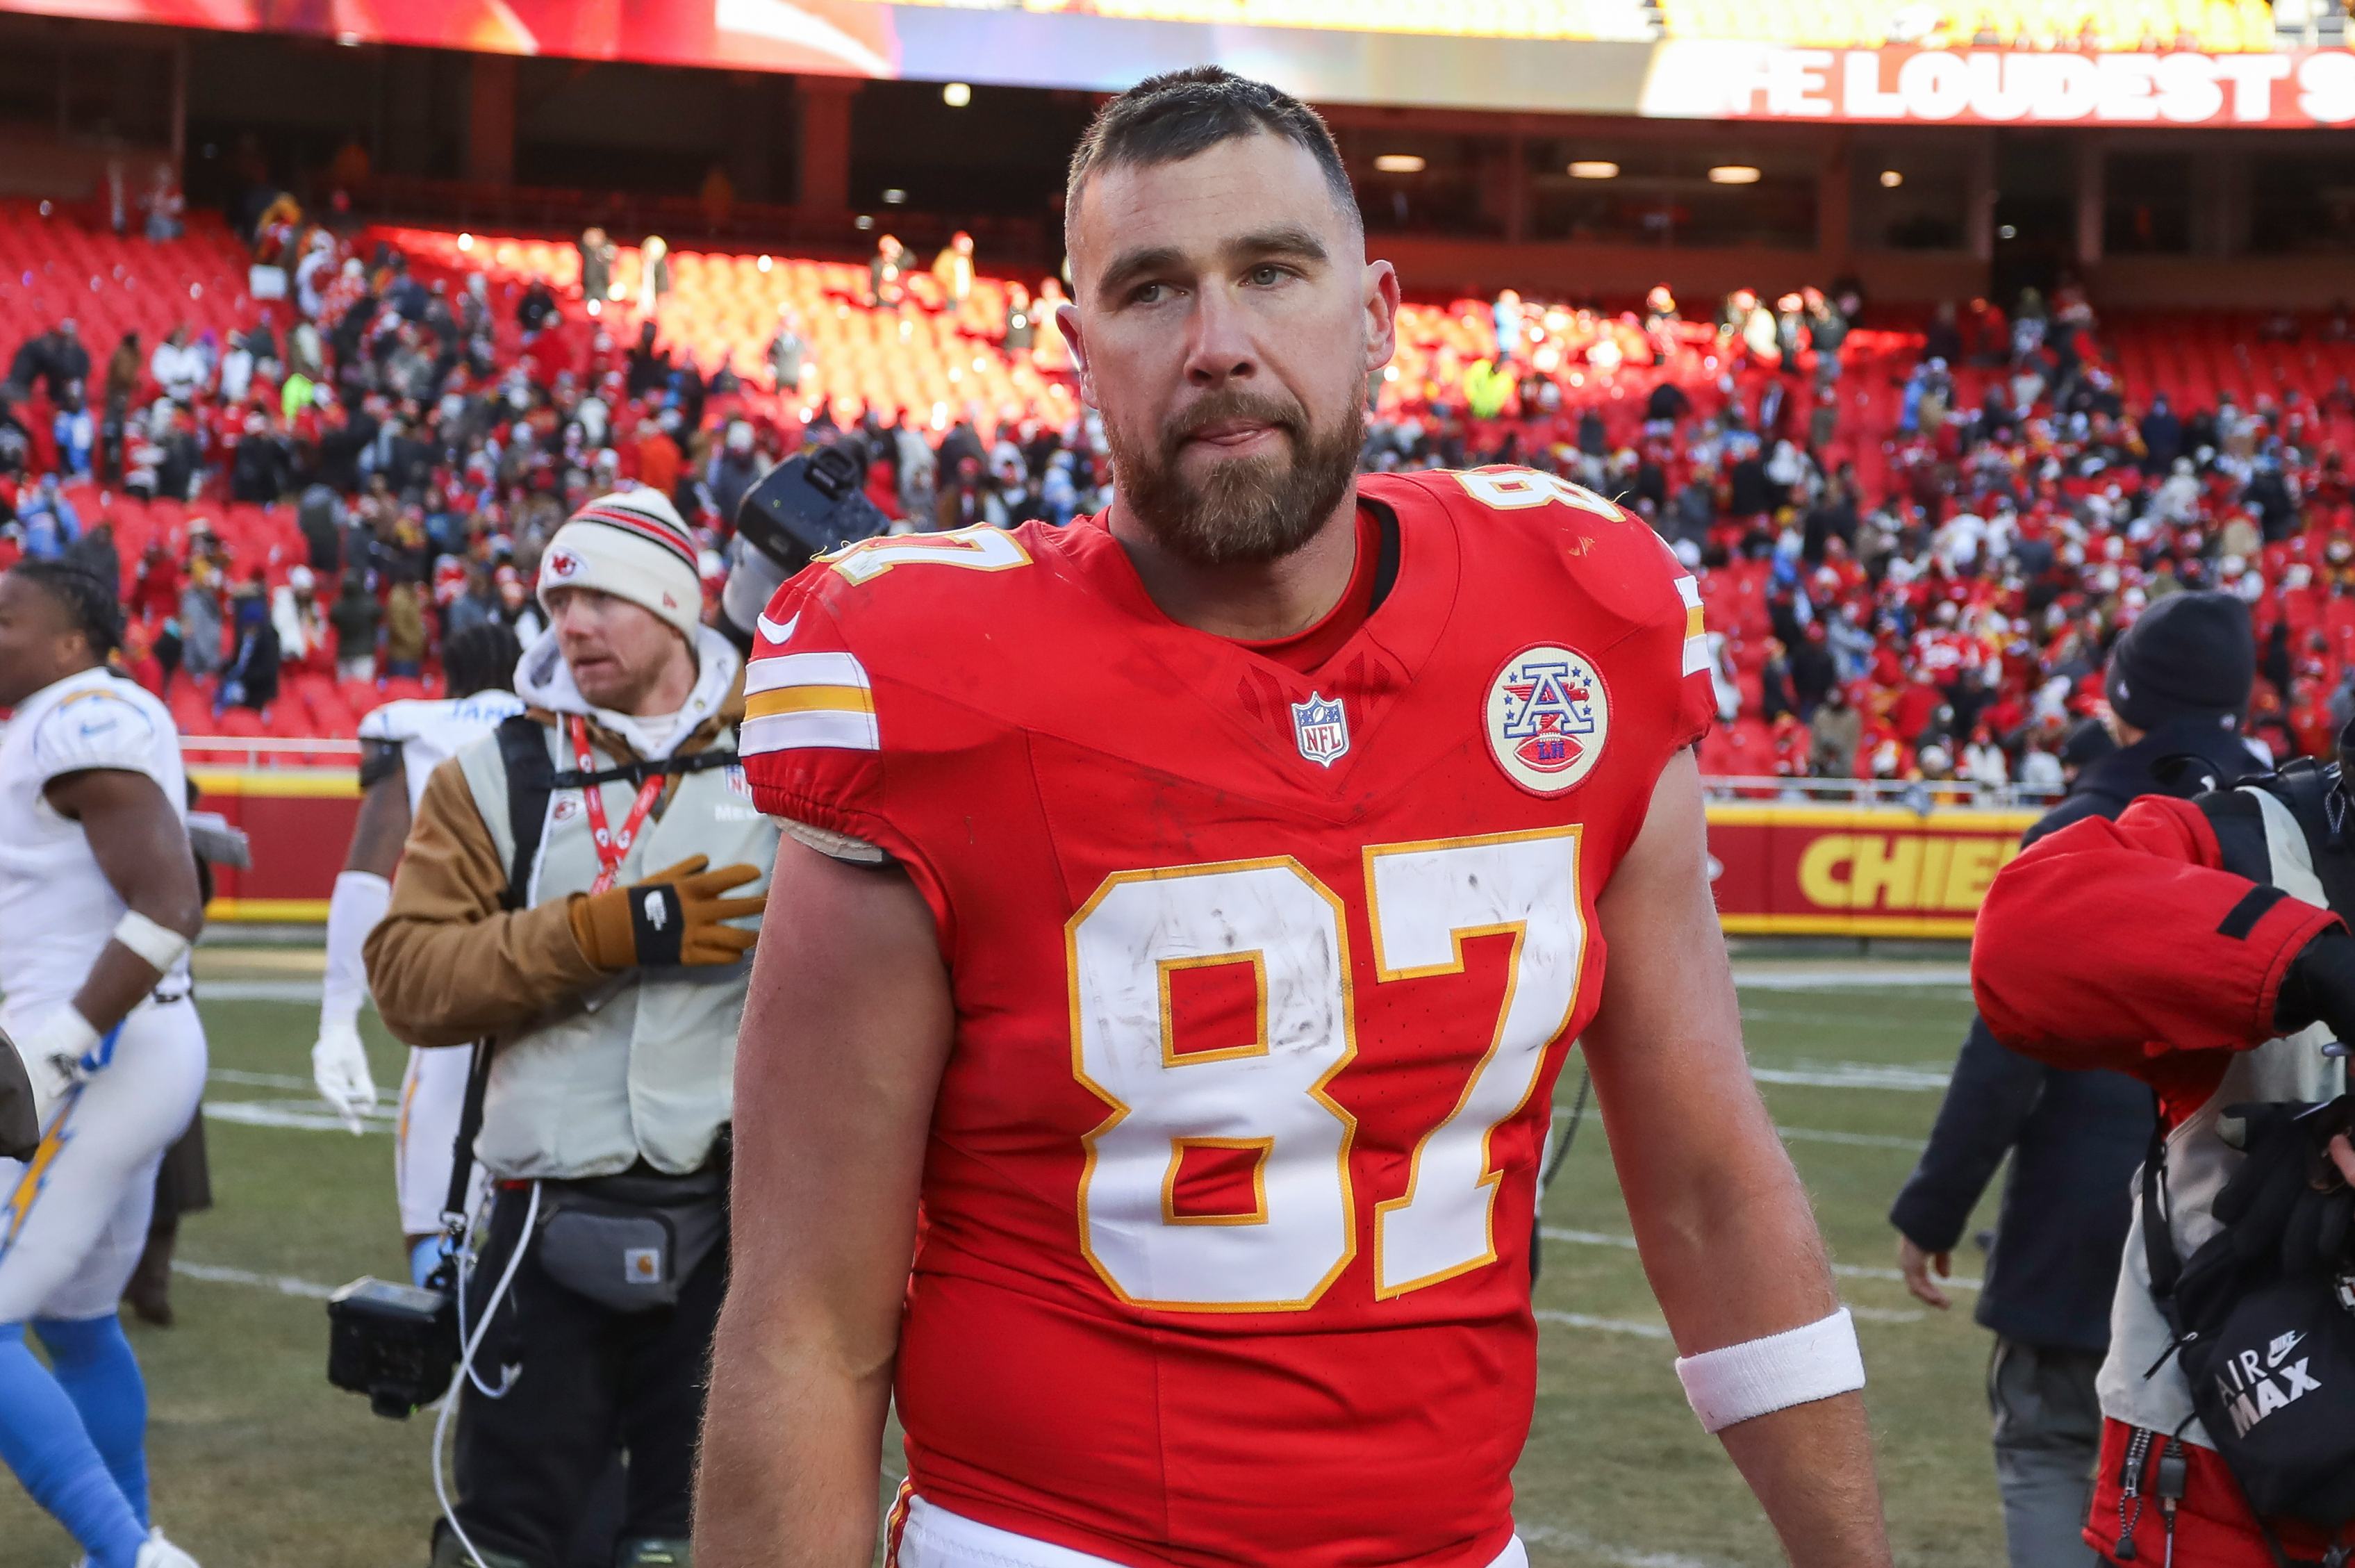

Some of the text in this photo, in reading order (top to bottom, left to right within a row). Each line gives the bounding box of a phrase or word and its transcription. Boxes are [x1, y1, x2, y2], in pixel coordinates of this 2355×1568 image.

[1844, 50, 2292, 124] LOUDEST
[1503, 661, 1595, 738] A
[1303, 723, 1341, 753] NFL
[1538, 741, 1565, 760] LH
[1064, 823, 1588, 1314] 87
[2214, 1349, 2268, 1408] AIR
[2228, 1356, 2322, 1439] MAX
